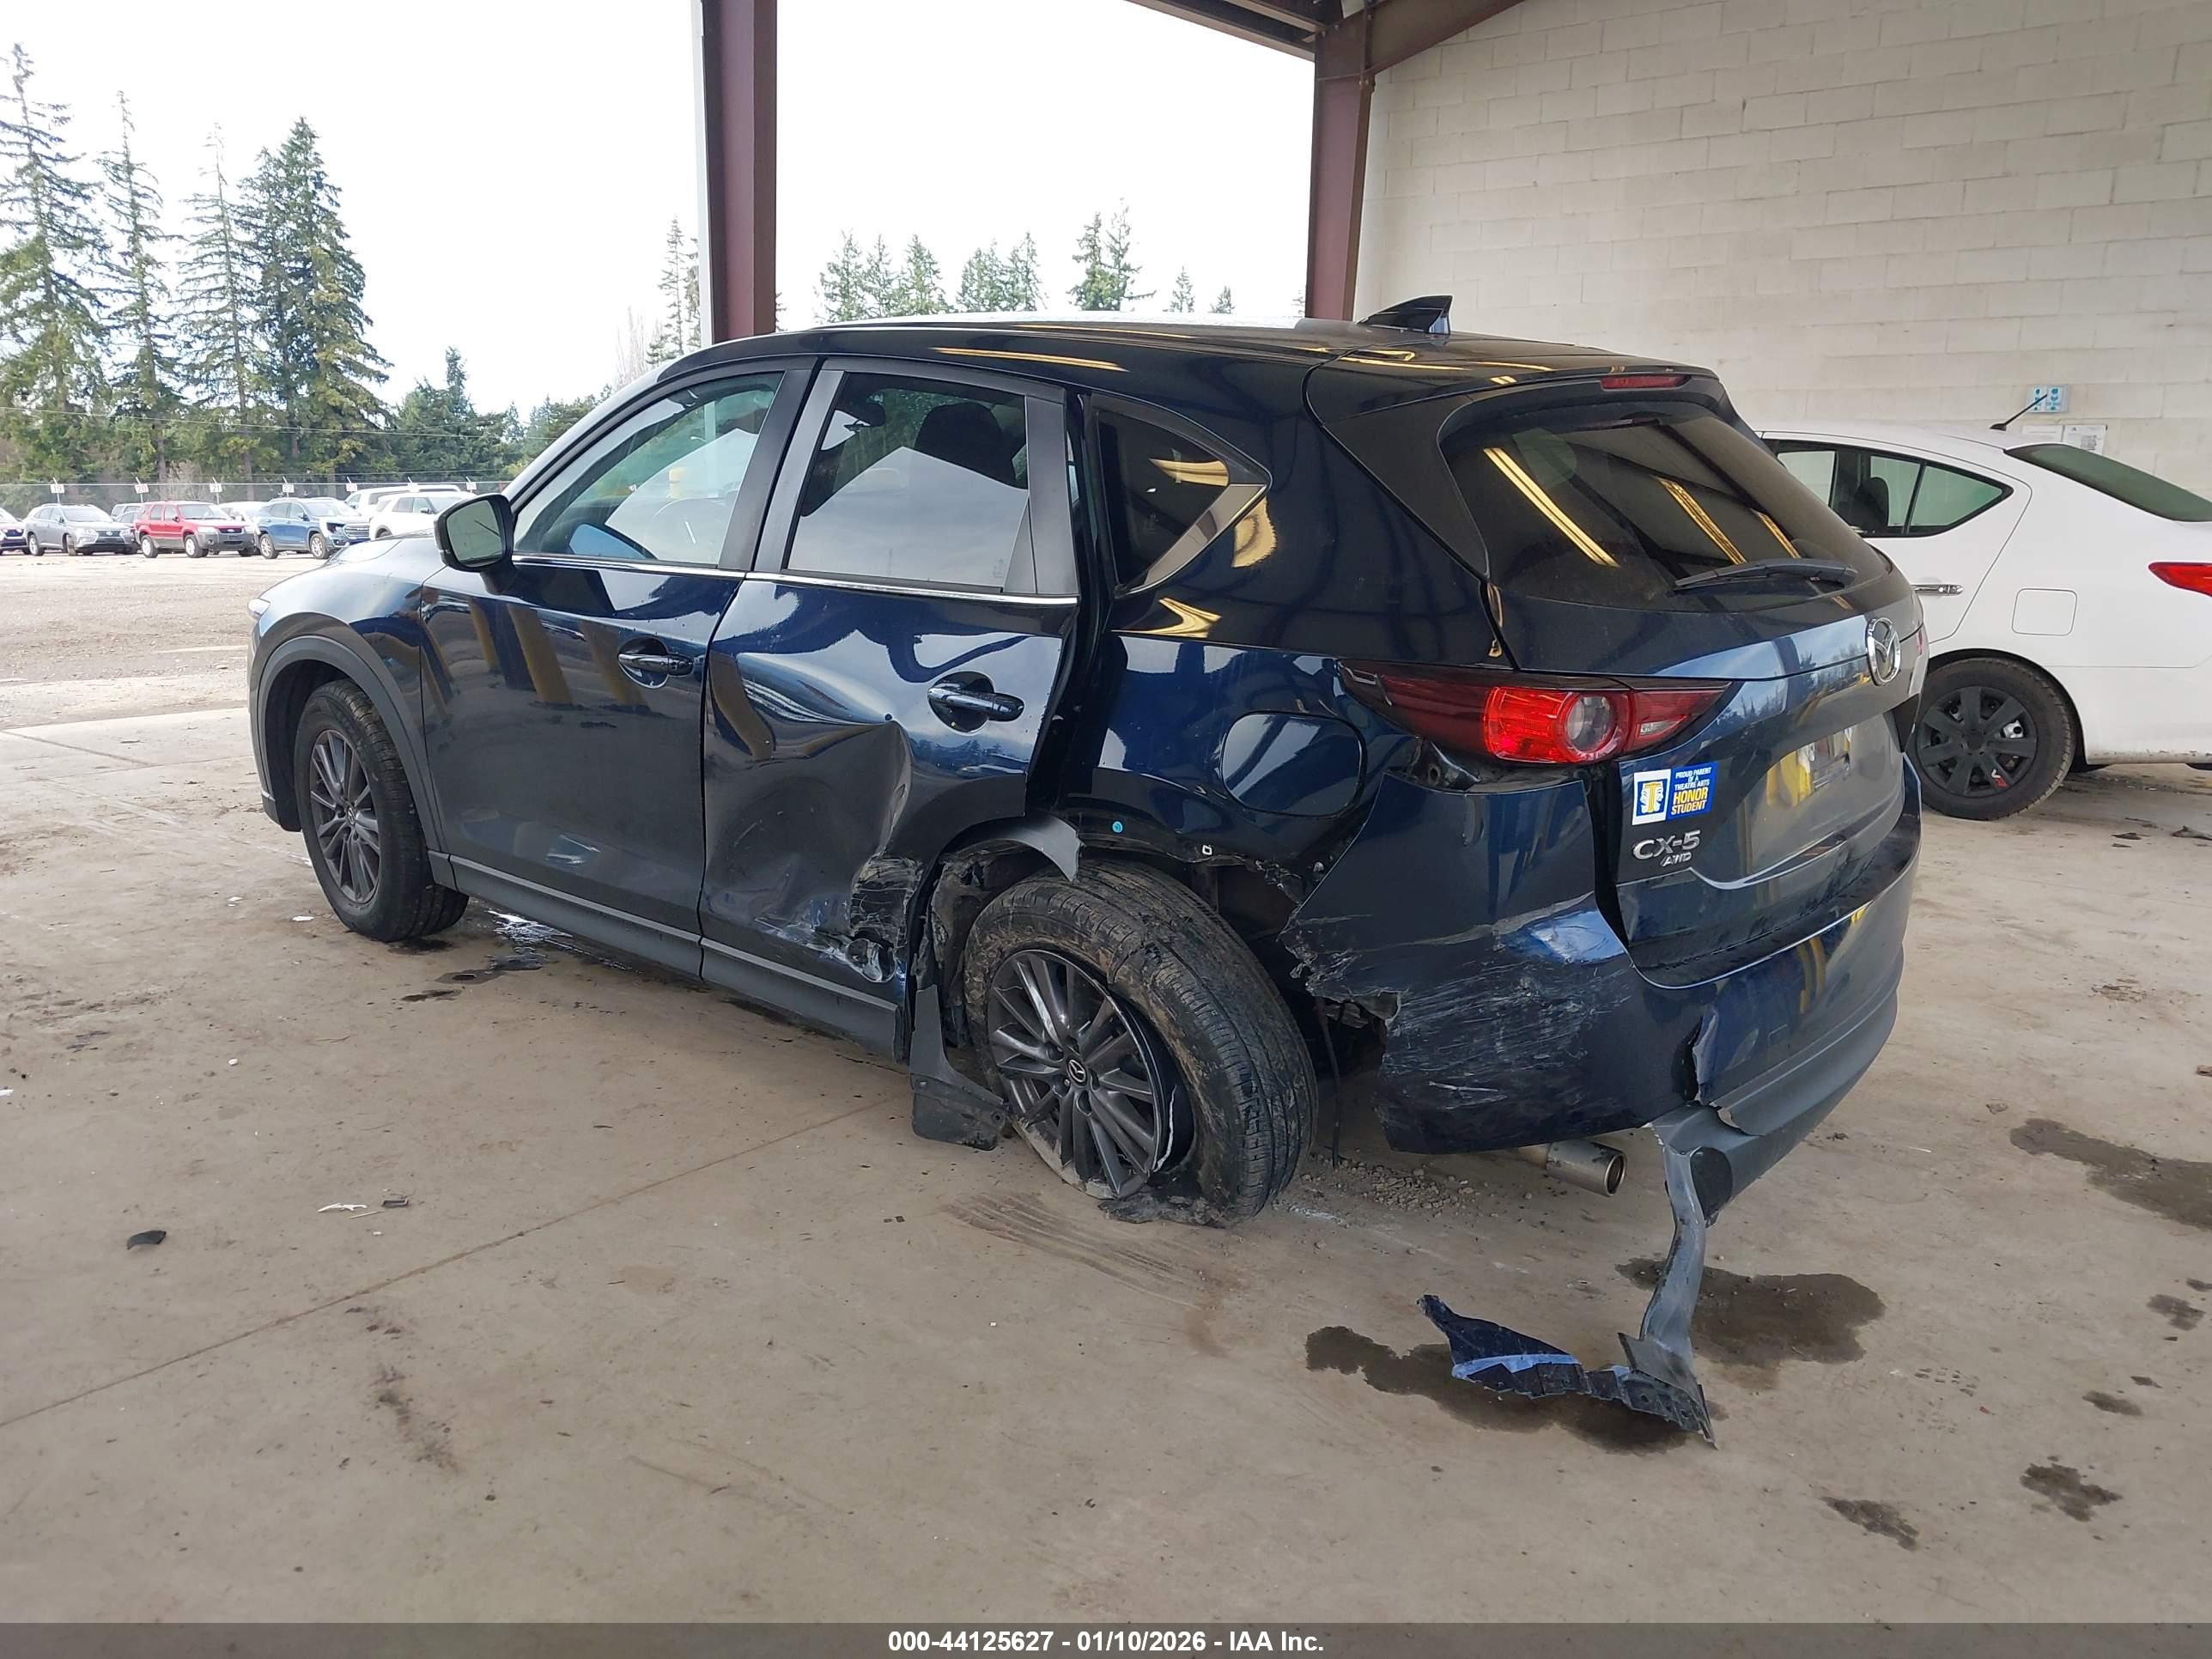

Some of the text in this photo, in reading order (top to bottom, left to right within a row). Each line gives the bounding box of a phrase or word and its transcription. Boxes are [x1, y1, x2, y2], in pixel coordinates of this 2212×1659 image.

[1675, 767, 1712, 779] PROUD PARENT
[1674, 781, 1697, 790] THEATRE
[1673, 787, 1709, 805] HONOR
[1670, 799, 1707, 815] STUDENT
[1633, 830, 1700, 860] CX-5
[1660, 852, 1692, 867] AWD
